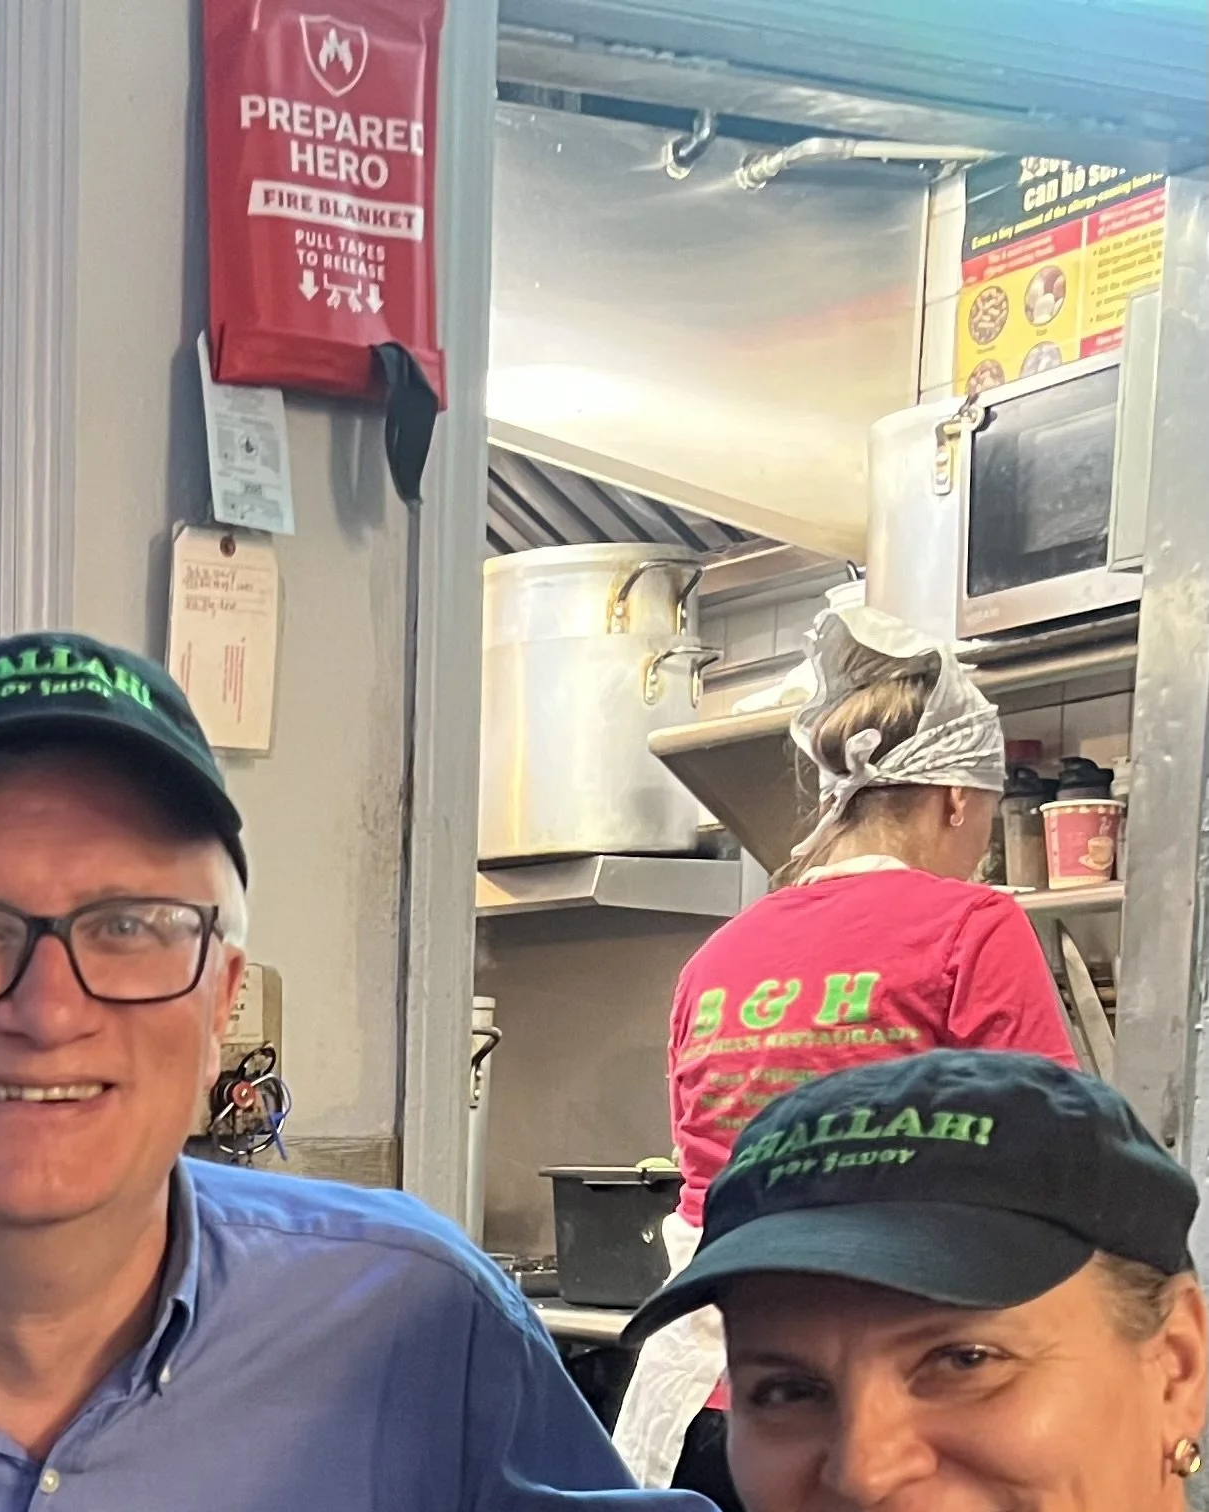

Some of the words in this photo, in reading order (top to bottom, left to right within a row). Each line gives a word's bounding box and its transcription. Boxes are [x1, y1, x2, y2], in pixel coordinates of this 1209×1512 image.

[290, 139, 389, 190] HERO
[262, 187, 313, 213] FIRE
[318, 196, 416, 229] BLANKET
[294, 228, 334, 251] PULL
[338, 236, 386, 262] TAPES
[296, 248, 319, 267] TO
[323, 253, 386, 282] RELEASE
[39, 678, 114, 699] favor
[740, 978, 803, 1030] &
[813, 971, 882, 1025] H
[766, 1158, 819, 1189] por
[821, 1148, 917, 1174] favor
